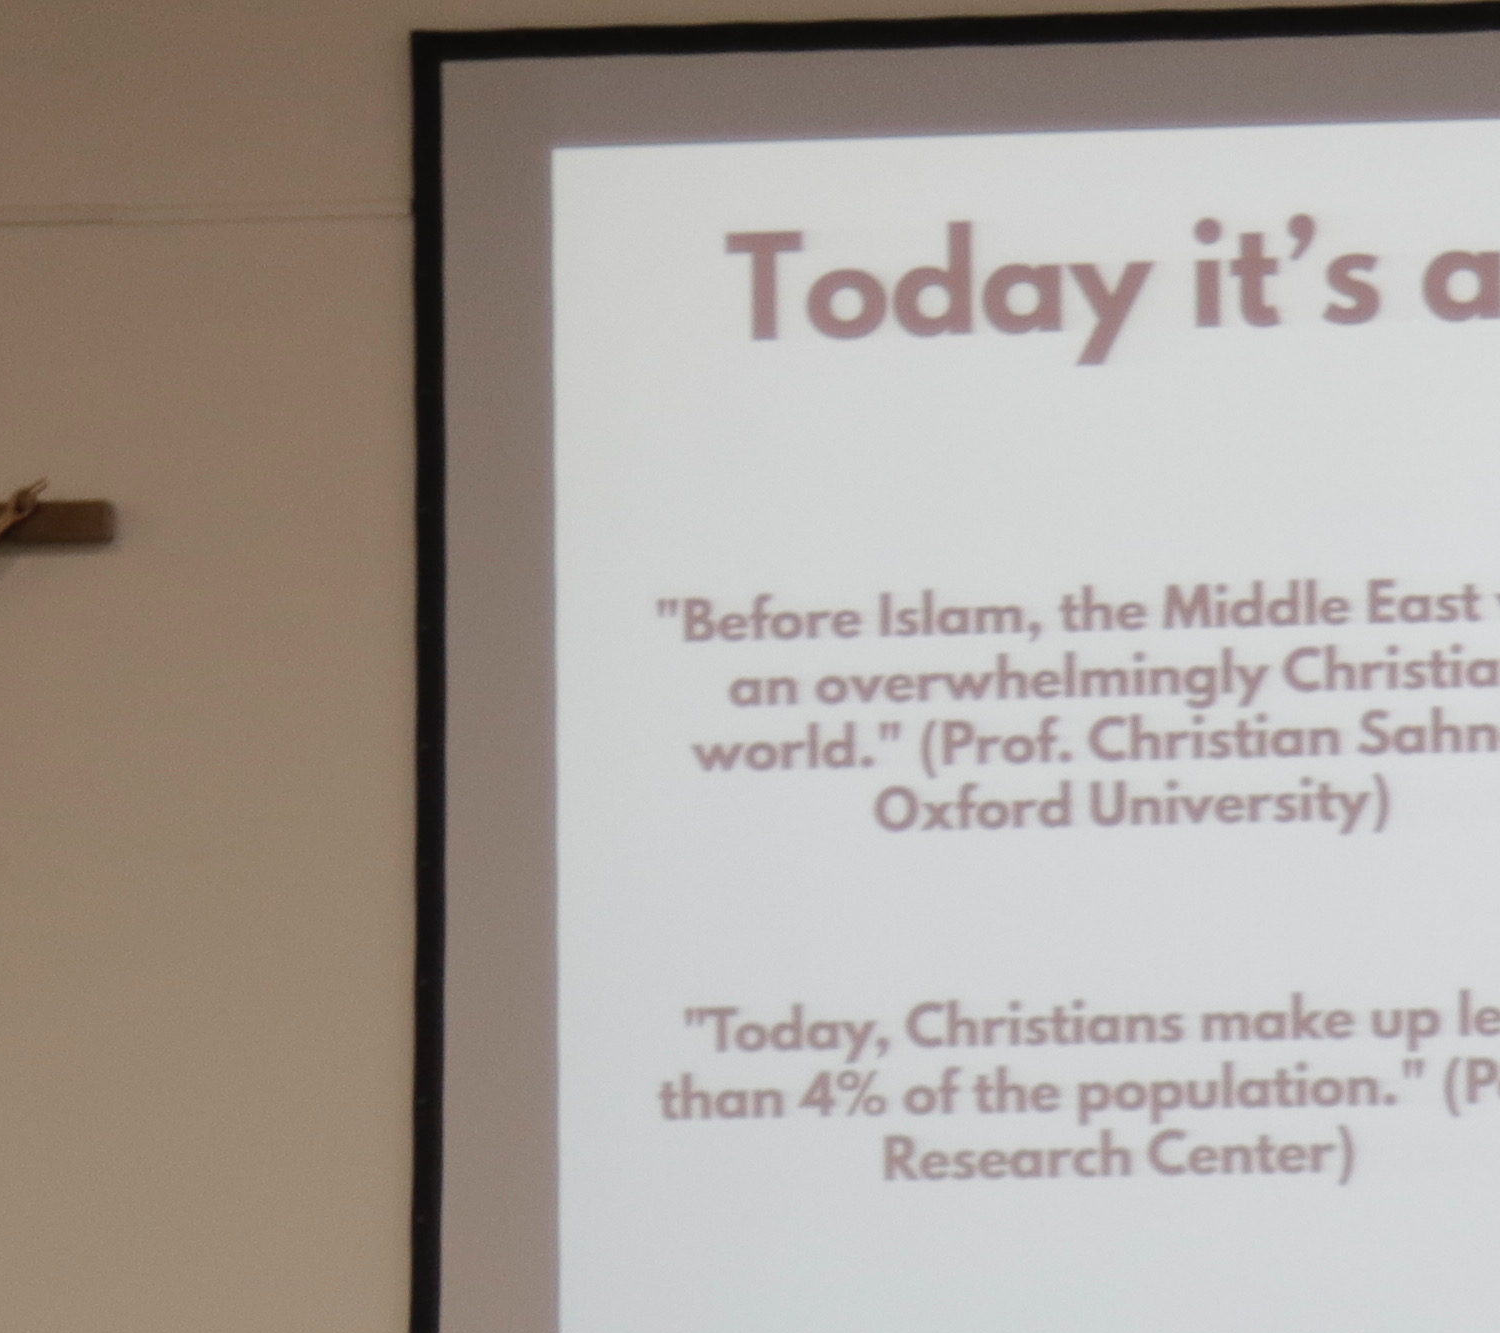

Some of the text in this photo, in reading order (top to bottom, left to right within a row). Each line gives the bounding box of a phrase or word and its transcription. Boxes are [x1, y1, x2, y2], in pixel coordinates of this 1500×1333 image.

[724, 220, 1154, 365] Today
[656, 595, 862, 642] "Before
[879, 589, 1042, 641] Islam,
[1059, 585, 1147, 632] the
[1163, 579, 1351, 629] Middle
[1367, 578, 1481, 624] East
[728, 676, 798, 707] an
[814, 651, 1269, 707] overwhelmingly
[691, 721, 901, 771] world."
[920, 717, 1072, 778] (Prof.
[1087, 713, 1341, 762] Christian
[873, 773, 1390, 835] Oxford University)
[684, 1005, 890, 1062] "Today,
[904, 999, 1185, 1049] Christians
[1201, 992, 1355, 1041] make
[1371, 1007, 1442, 1052] up
[658, 1072, 784, 1121] than
[798, 1068, 887, 1117] 4%
[902, 1066, 961, 1115] of
[972, 1065, 1061, 1114] the
[1077, 1056, 1425, 1123] population."
[883, 1123, 1355, 1185] Research Center)
